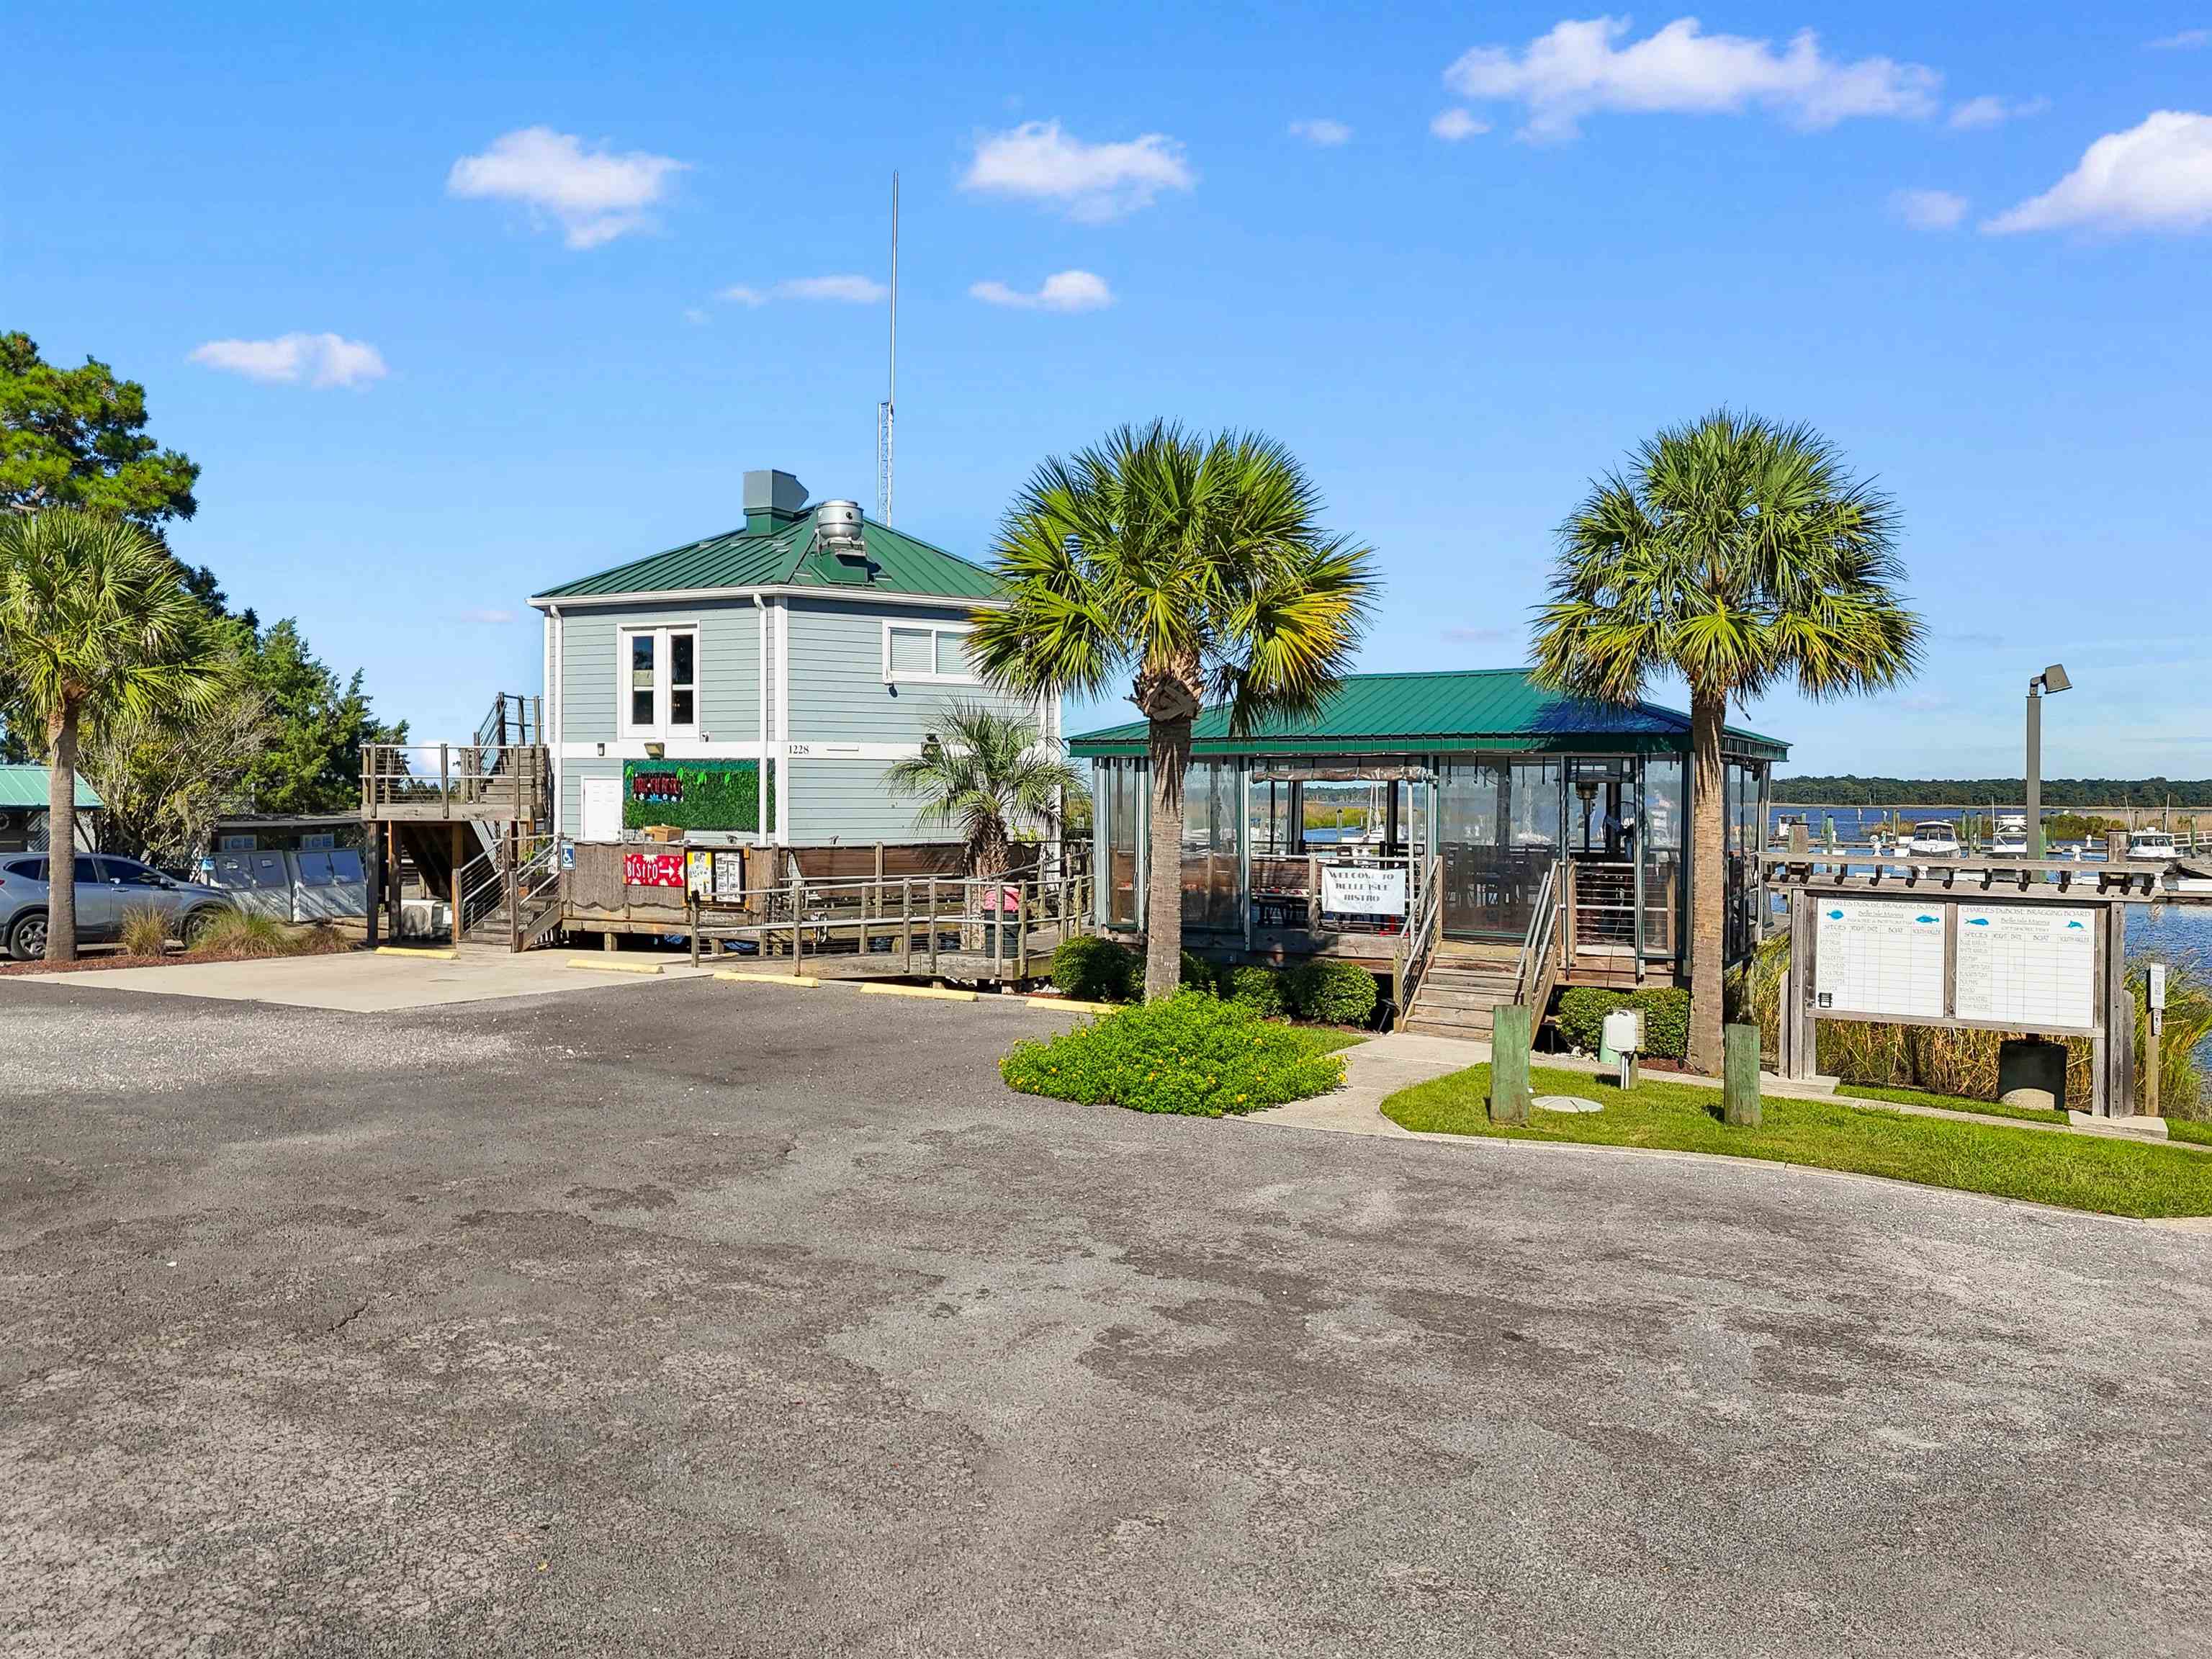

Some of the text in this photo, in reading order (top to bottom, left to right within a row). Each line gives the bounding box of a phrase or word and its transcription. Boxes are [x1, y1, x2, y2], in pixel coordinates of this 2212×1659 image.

[788, 745, 809, 755] 1228
[224, 838, 255, 849] ICE
[304, 835, 332, 847] ICE
